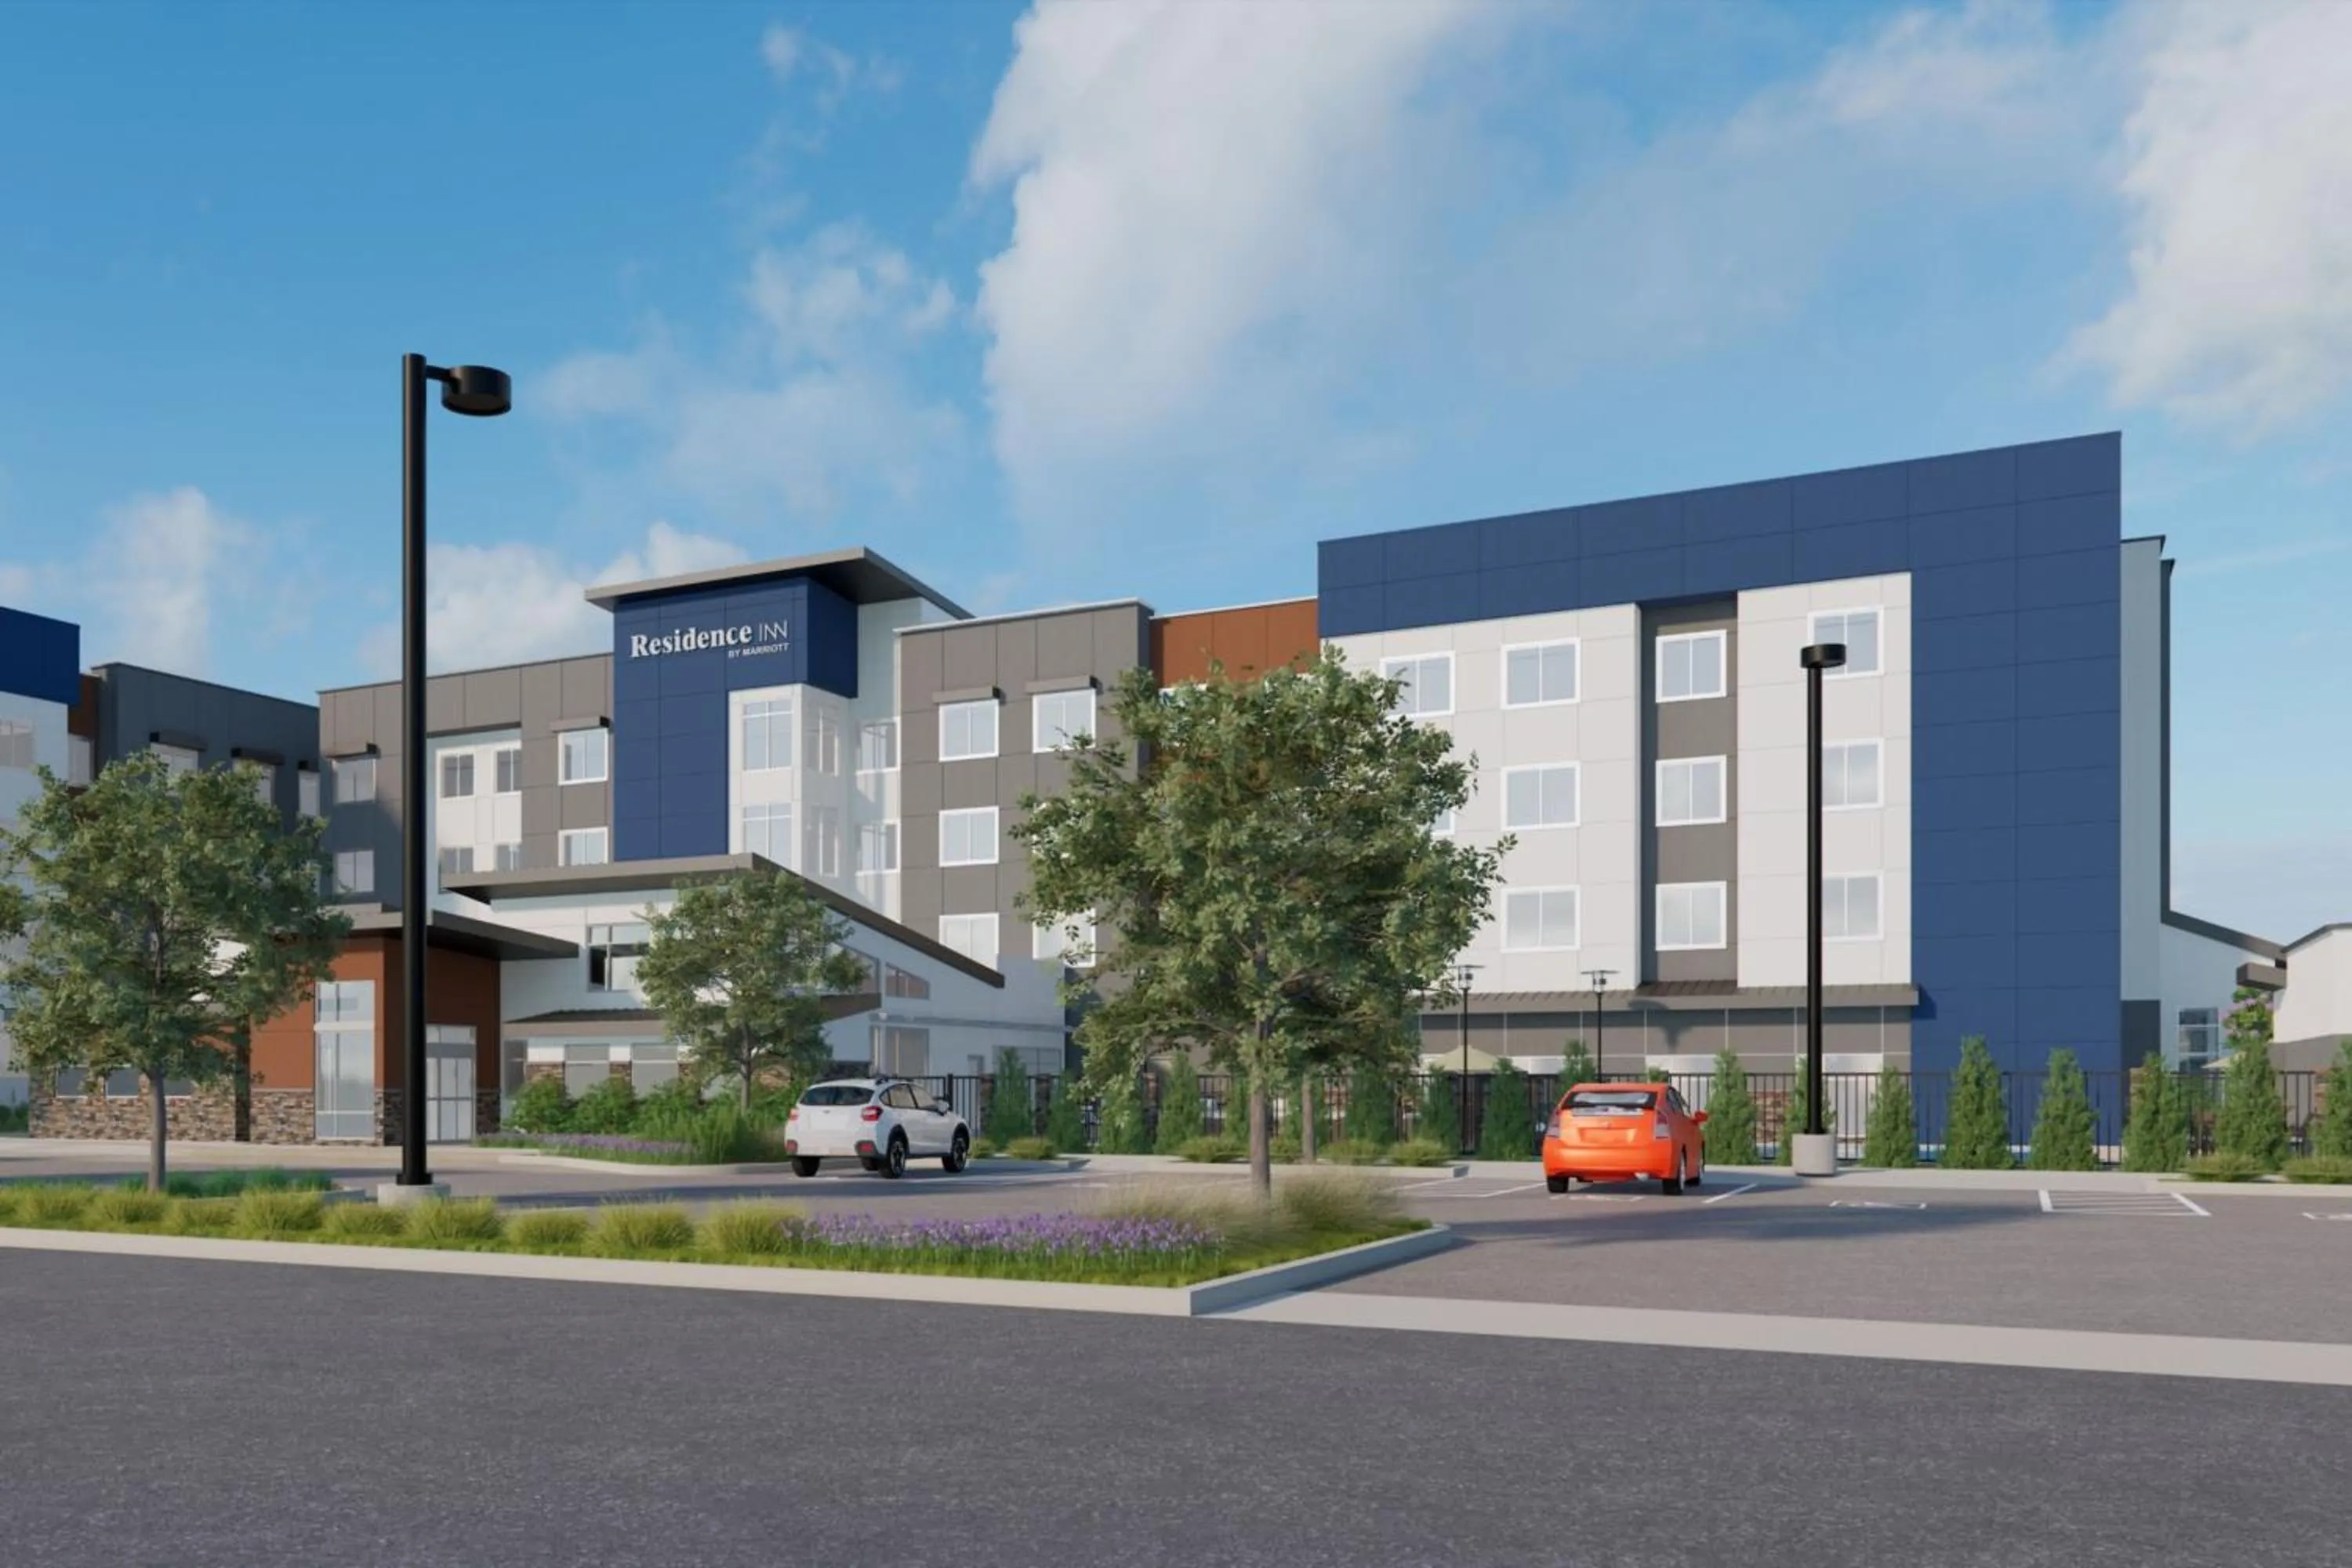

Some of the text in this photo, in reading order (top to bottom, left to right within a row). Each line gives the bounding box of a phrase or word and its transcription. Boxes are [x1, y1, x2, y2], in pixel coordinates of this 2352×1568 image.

[630, 619, 788, 658] Residence INN
[728, 643, 790, 659] BY MARRIOTT
